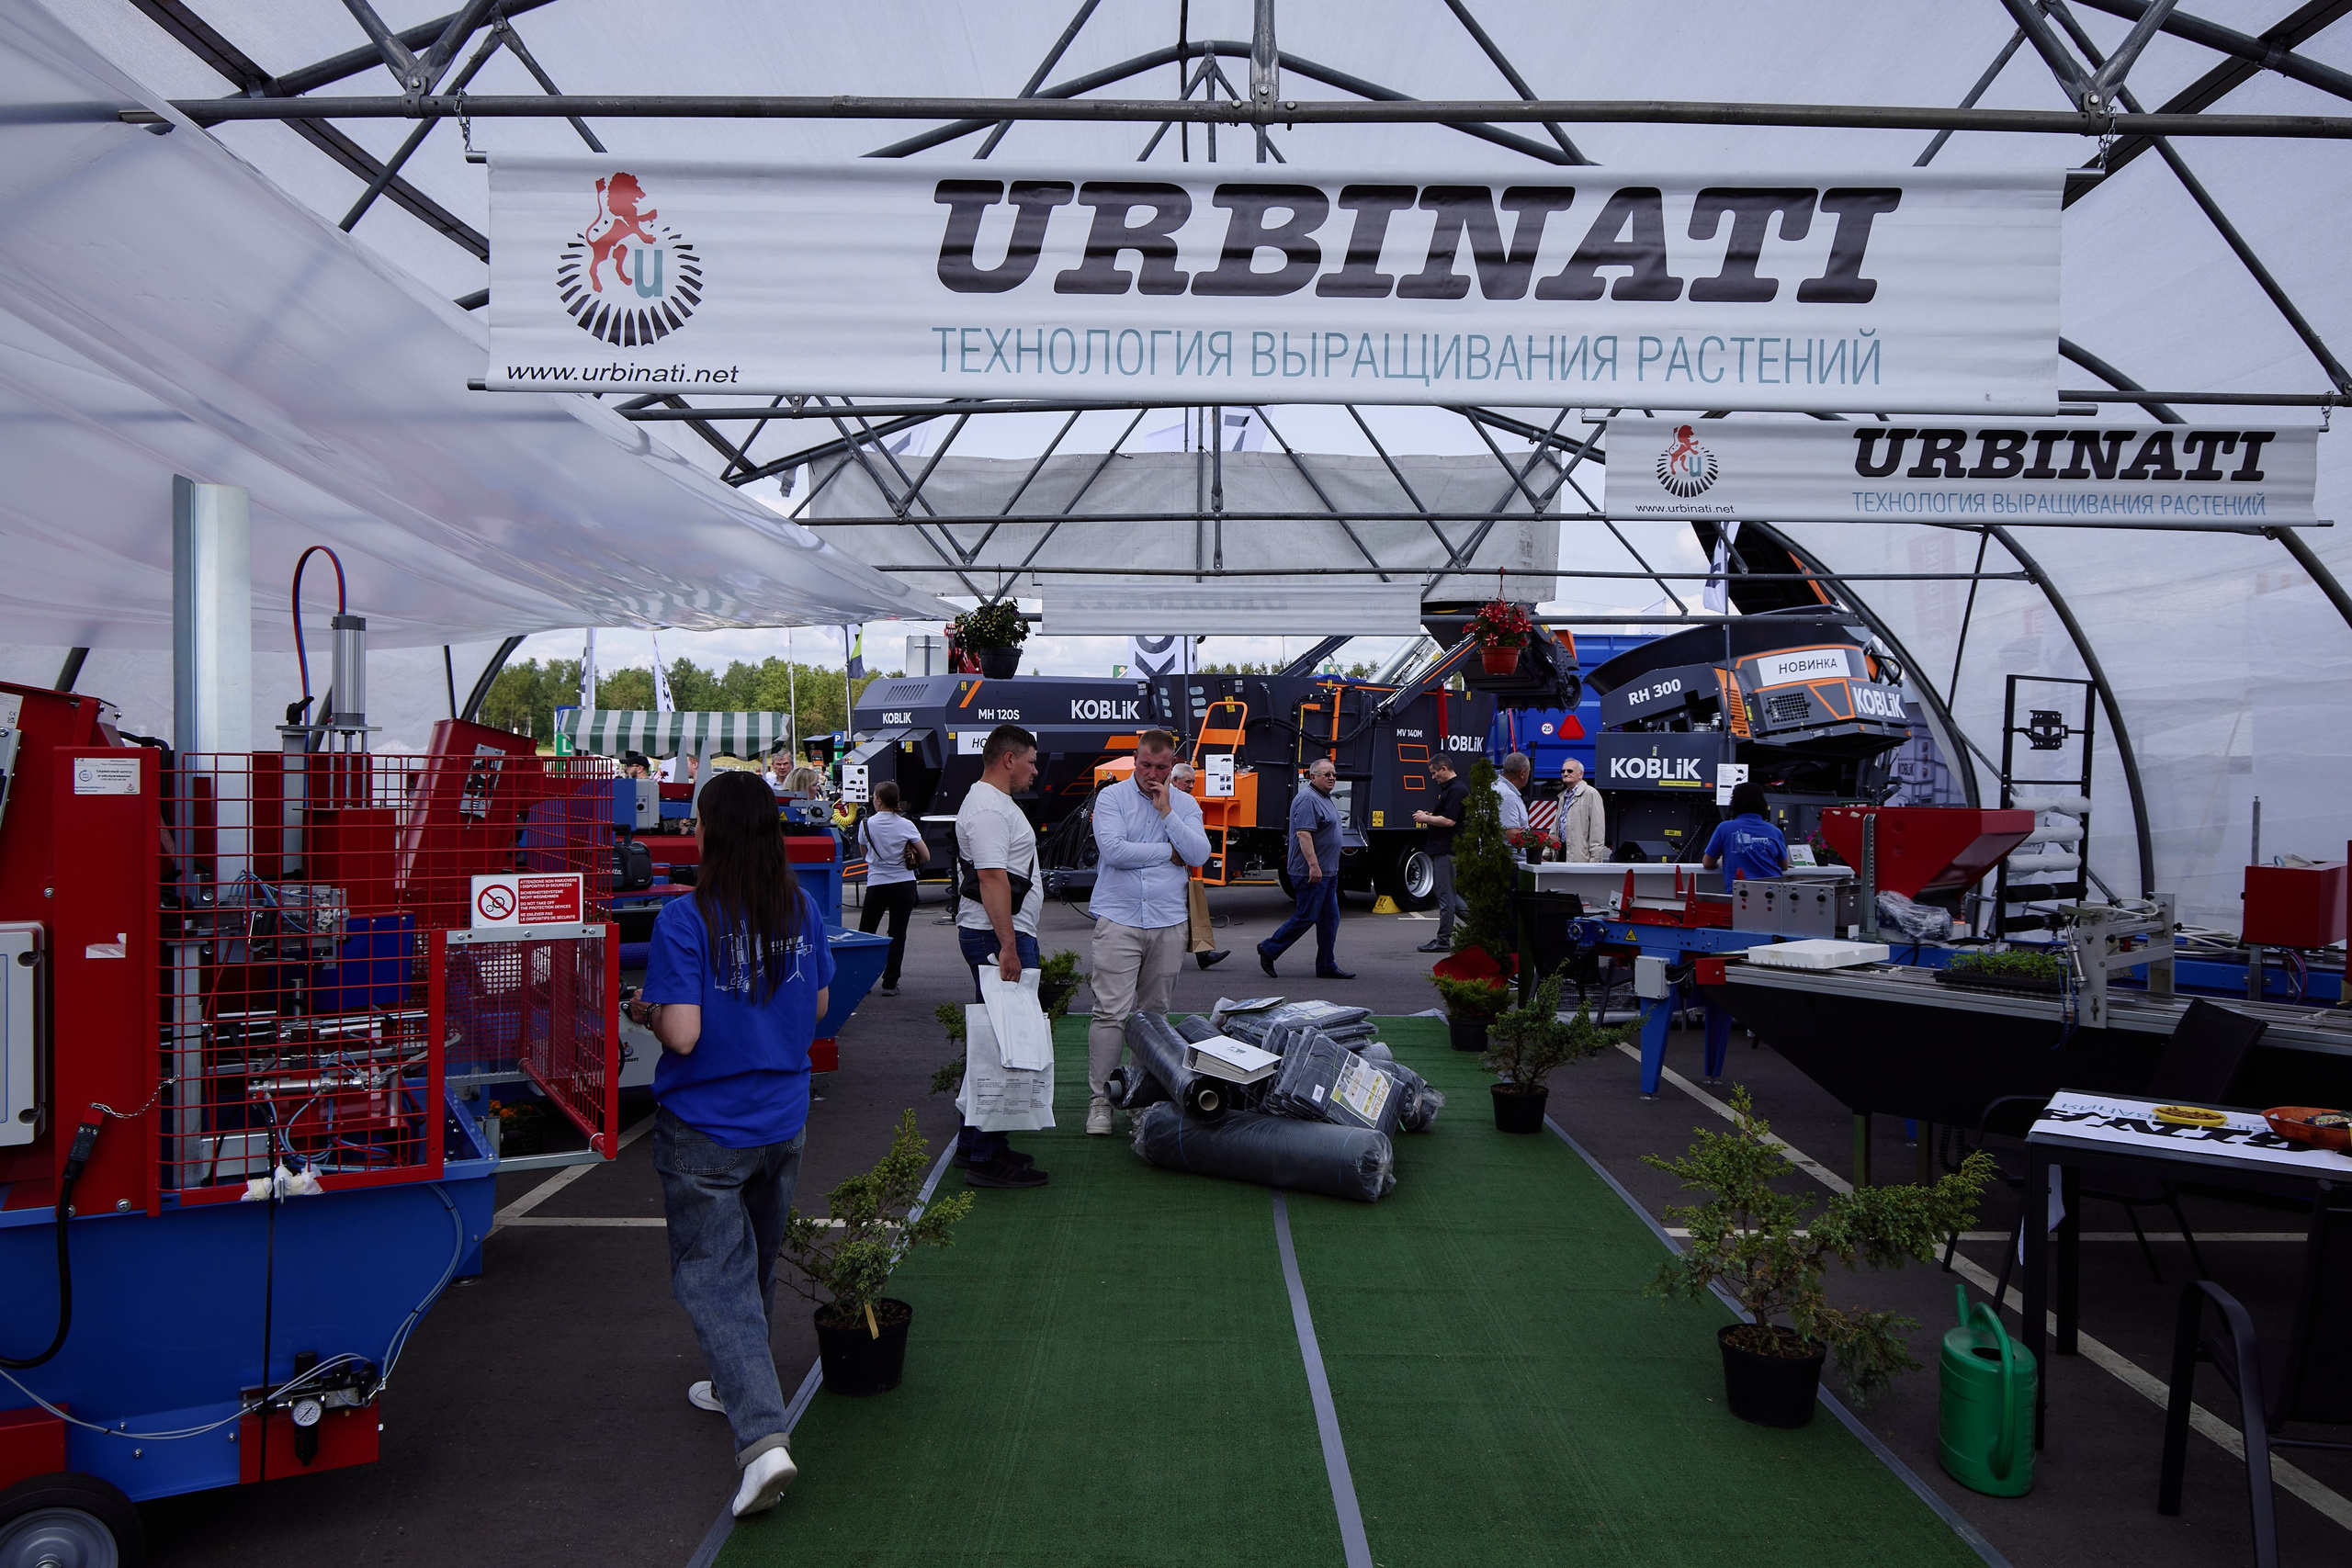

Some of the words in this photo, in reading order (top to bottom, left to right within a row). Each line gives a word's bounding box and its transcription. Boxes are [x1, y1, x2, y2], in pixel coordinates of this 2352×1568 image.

[934, 179, 1903, 303] URBINATI
[933, 327, 1232, 378] ТЕХНОЛОГИЯ
[1253, 332, 1618, 387] ВЫРАЩИВАНИЯ
[1638, 328, 1881, 385] РАСТЕНИЙ
[506, 365, 739, 384] www.urbinati.net
[1853, 427, 2277, 482] URBINATI
[1635, 503, 1735, 514] www.urbinati.net
[1852, 491, 1985, 513] ТЕХНОЛОГИЯ
[1993, 492, 2153, 517] ВЫРАЩИВАНИЯ
[2161, 491, 2267, 516] РАСТЕНИЙ
[1778, 658, 1838, 674] НОВИНКА
[1628, 687, 1650, 705] RH
[1654, 678, 1682, 698] 300
[978, 708, 995, 720] MH
[997, 708, 1020, 721] 120S
[1396, 728, 1407, 737] MV
[1408, 729, 1422, 738] 140M
